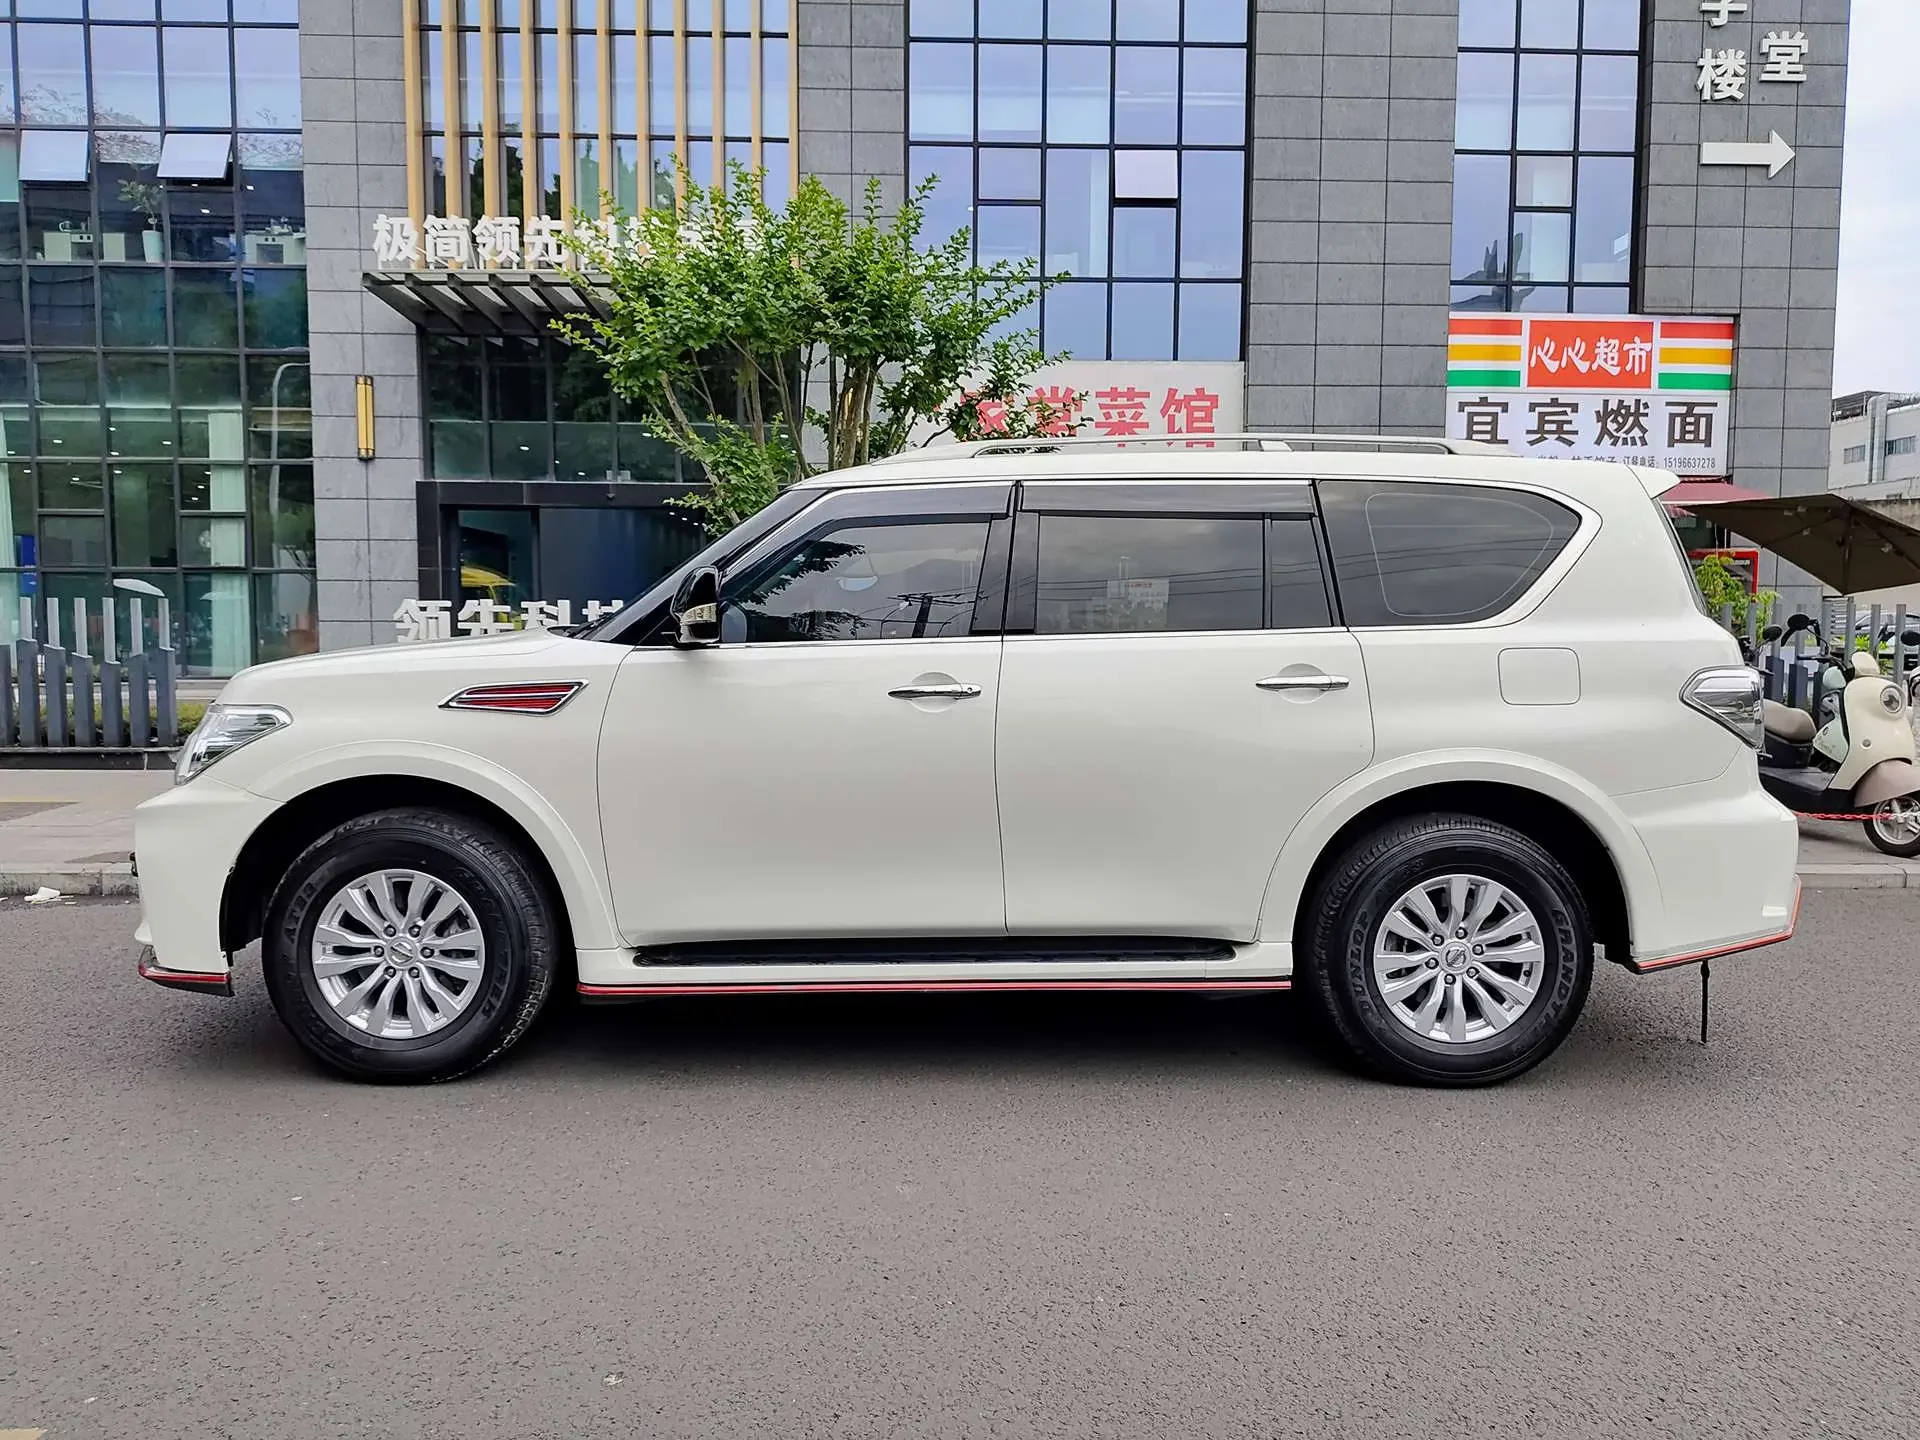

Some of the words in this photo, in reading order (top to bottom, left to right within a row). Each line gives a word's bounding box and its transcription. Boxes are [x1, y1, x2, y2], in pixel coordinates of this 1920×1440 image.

[1758, 30, 1809, 83] 堂
[1530, 336, 1653, 376] 心心超市
[1457, 396, 1719, 449] 宜宾燃面
[1663, 457, 1716, 469] 15196637278
